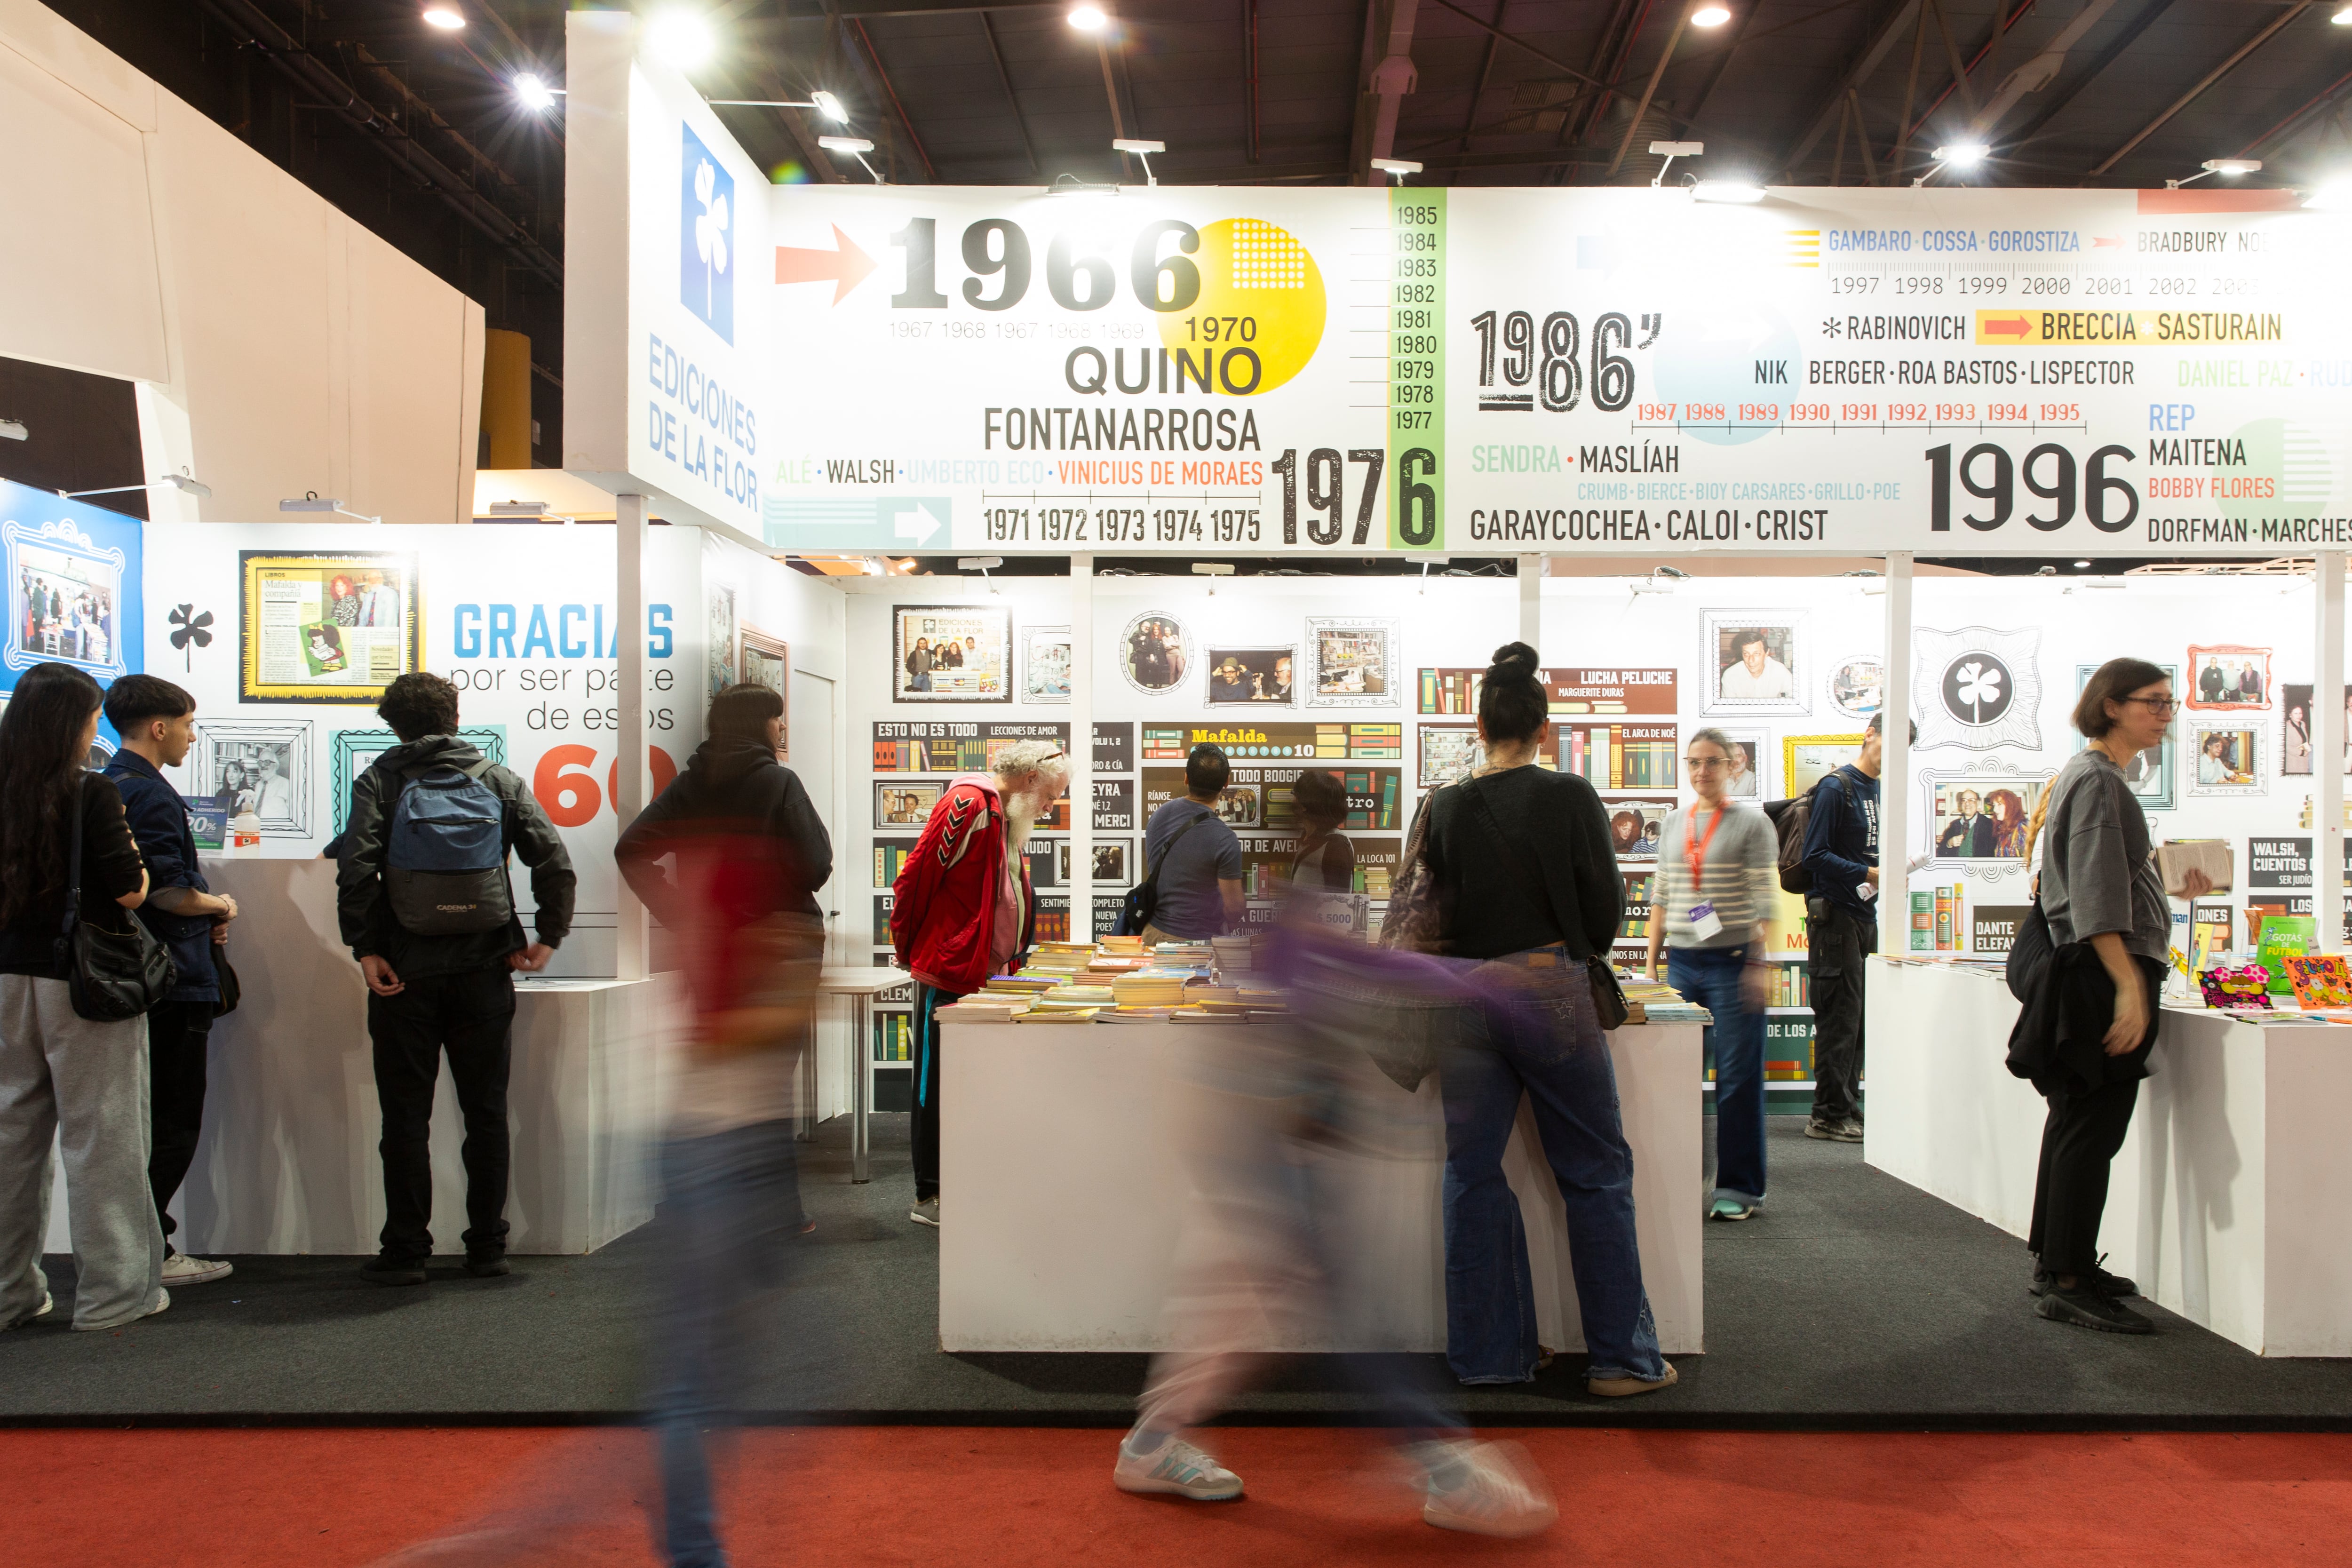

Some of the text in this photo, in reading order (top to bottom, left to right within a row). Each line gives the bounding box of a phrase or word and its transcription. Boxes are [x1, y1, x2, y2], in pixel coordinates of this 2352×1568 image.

[1399, 207, 1437, 224] 1985
[1397, 233, 1437, 251] 1984
[1830, 230, 2078, 251] GAMBARO COSSA GOROSTIZA
[2138, 232, 2227, 252] BRADBURY
[889, 216, 1201, 312] 1966
[1397, 259, 1436, 277] 1983
[1397, 285, 1434, 302] 1982
[1833, 277, 2196, 294] 1997 1998 1999 2000 2001 2002
[1398, 310, 1430, 328] 1981
[1848, 313, 2281, 340] RABINOVICH BRECCIA SASTURAIN
[889, 317, 1256, 342] 1967 1968 1967 1968 1969 1970
[1398, 336, 1436, 353] 1980
[1065, 346, 1261, 396] QUINO
[1398, 361, 1433, 379] 1979
[1756, 360, 2133, 384] NIK BERGER ROA BASTOS LISPECTOR
[2178, 360, 2249, 387] DANIEL
[2258, 360, 2293, 387] PAZ
[650, 332, 755, 455] EDICIONES
[1397, 385, 1433, 403] 1978
[1397, 411, 1431, 429] 1977
[1638, 404, 2079, 420] 1987 1988 1989 1990 1991 1992 1993 1994 1995
[2150, 404, 2194, 431] REP
[985, 408, 1261, 451] FONTANARROSA
[650, 400, 757, 512] DE LA FLOR
[1472, 439, 1678, 472] SENDRA MASLÍAH
[2150, 439, 2246, 465] MAITENA
[773, 454, 1262, 485] ALÉ WALSH UMBERTO ECO VINICIUS DE MORAES
[1271, 447, 1436, 546] 1976
[1578, 483, 1900, 500] CRUMB BIERCE BIOY CARSARES GRILLO POE
[1925, 443, 2139, 533] 1996
[2149, 478, 2274, 498] BOBBY FLORES
[984, 509, 1260, 541] 1971 1972 1973 1974 1975
[1471, 510, 1828, 540] GARAYCOCHEA CALOI CRIST
[2149, 519, 2247, 542] DORFMAN
[454, 604, 673, 658] GRACIS
[451, 669, 572, 690] por ser
[1581, 671, 1672, 684] LUCHA PELUCHE
[1558, 688, 1624, 697] MARGUERITE DURAS
[527, 701, 569, 730] de
[879, 724, 977, 737] ESTO NO ES TODO
[991, 726, 1057, 735] LECCIONES DE AMOR
[1192, 729, 1267, 742] Mafalda
[1622, 727, 1675, 738] EL ARCA DE NOÉ
[1294, 745, 1314, 756] 10
[1105, 759, 1123, 770] & CÍA
[1231, 770, 1260, 782] TODO
[1095, 814, 1130, 827] MERCI
[1385, 854, 1395, 863] 101
[2253, 843, 2299, 857] WALSH,
[2253, 858, 2305, 871] CUENTOS
[2279, 873, 2312, 885] SER JUDÍO
[2291, 899, 2312, 912] LOS
[1096, 911, 1117, 920] NUEVA
[1326, 914, 1351, 923] 5000
[1976, 922, 2015, 935] DANTE
[2335, 961, 2348, 979] 4
[1767, 1024, 1781, 1037] DE
[1785, 1024, 1806, 1037] LOS
